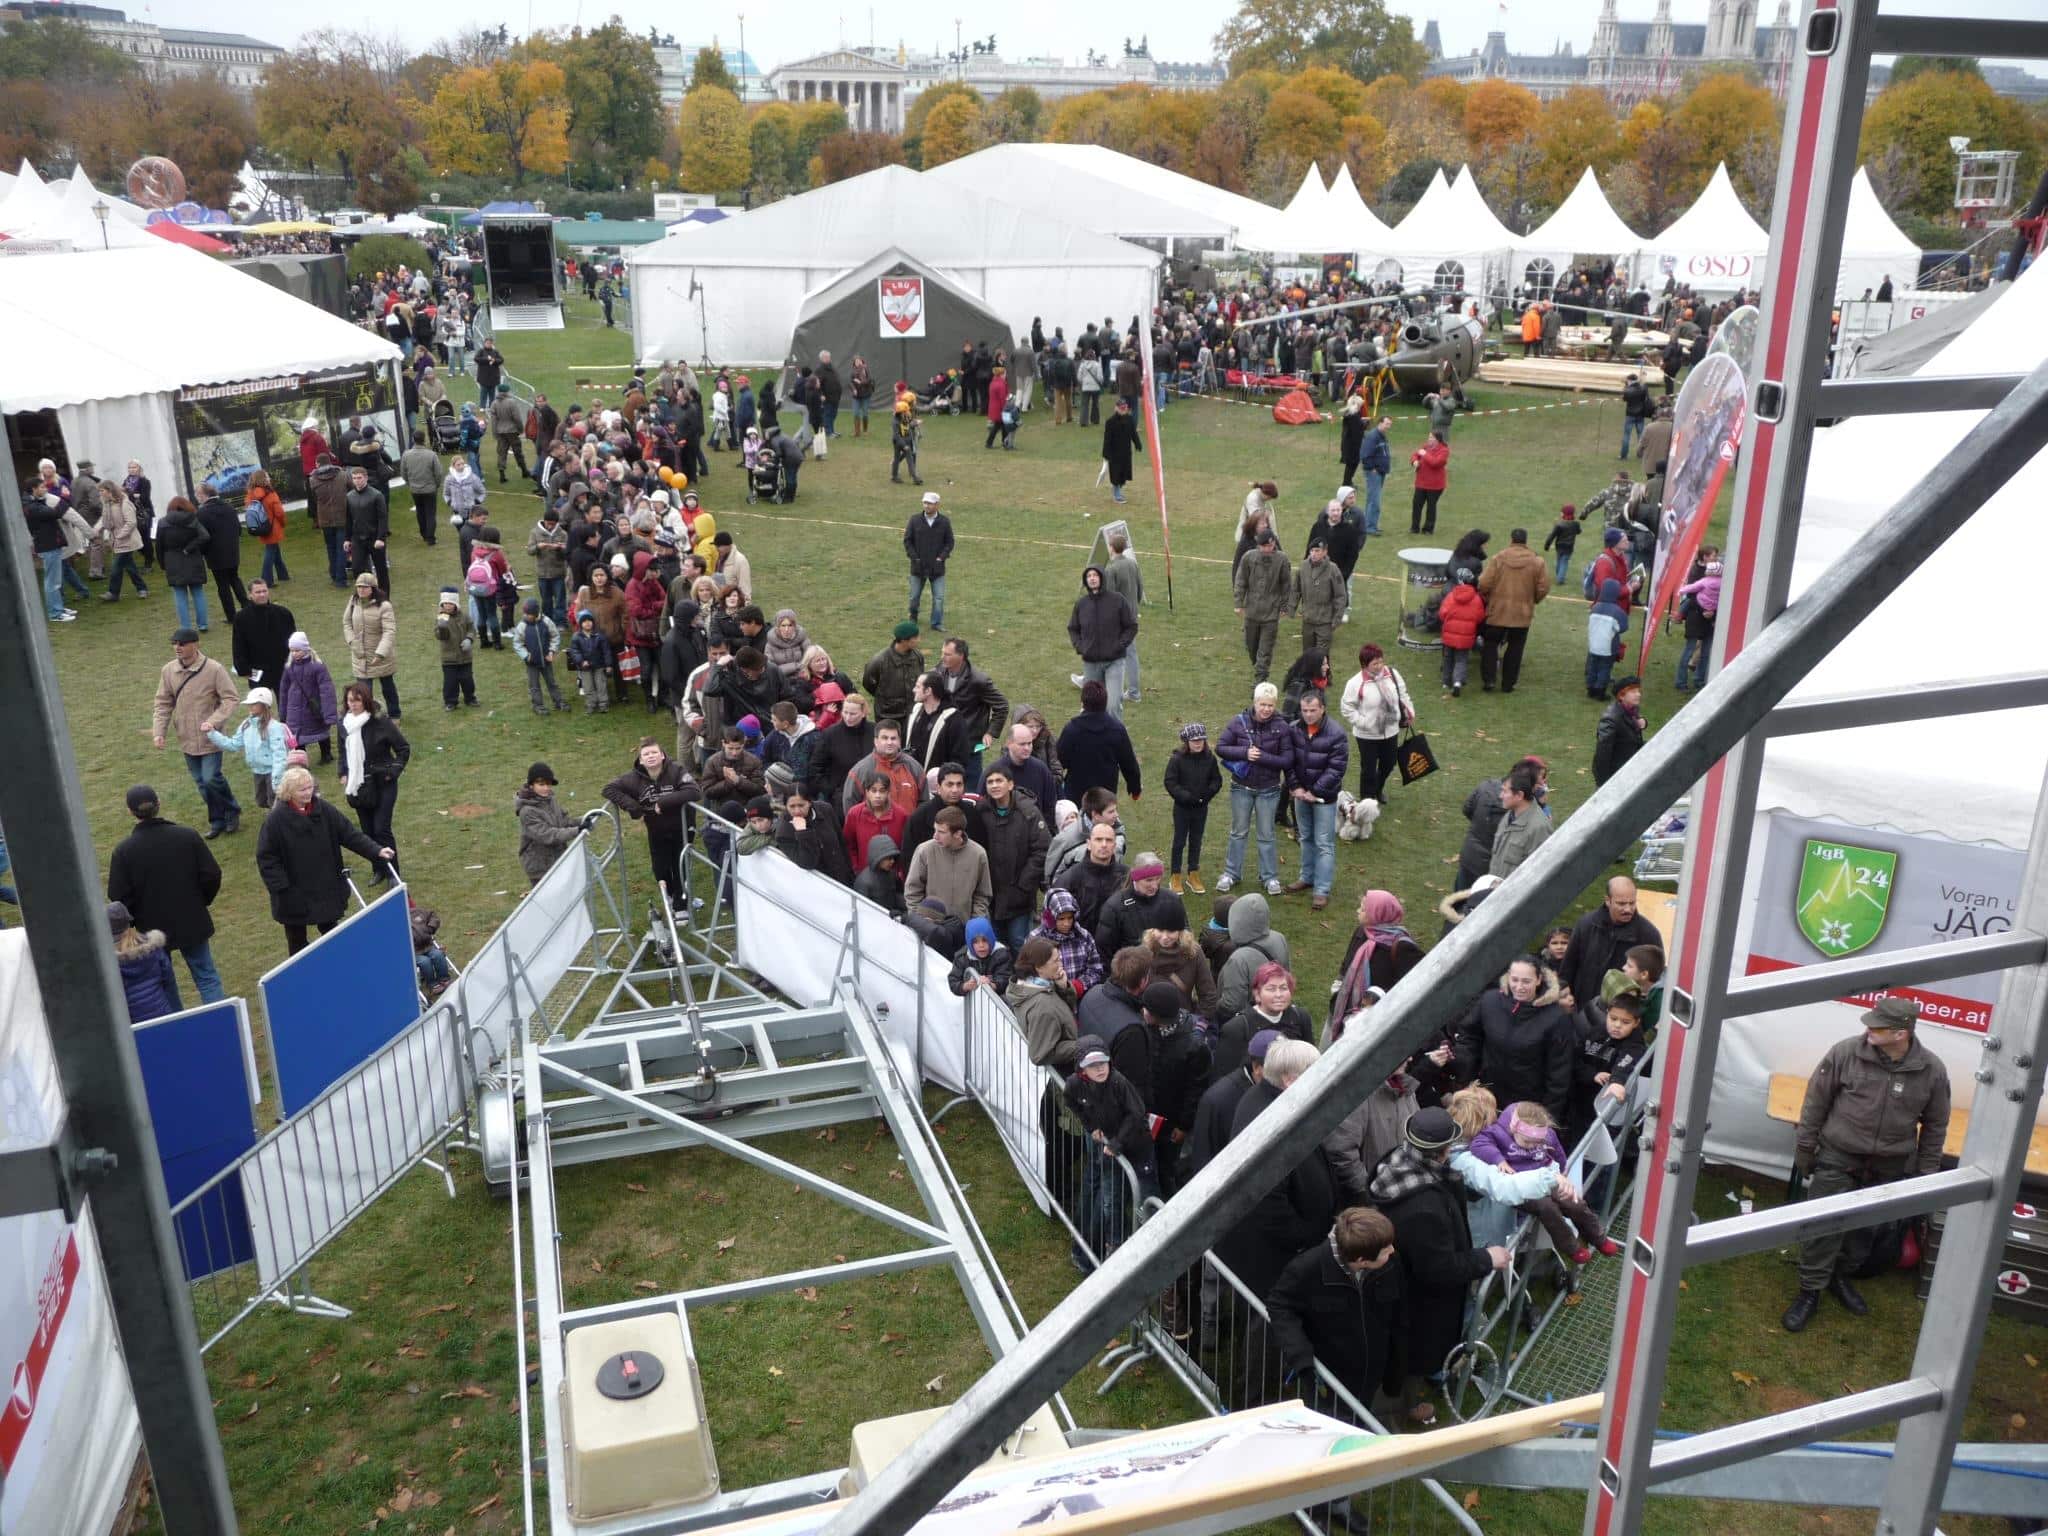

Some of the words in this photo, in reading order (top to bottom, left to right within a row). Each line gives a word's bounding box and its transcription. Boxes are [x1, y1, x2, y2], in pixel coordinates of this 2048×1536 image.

[1812, 845, 1845, 861] JgB
[1855, 867, 1889, 888] 24
[1941, 885, 2000, 909] Voran
[1933, 905, 2012, 938] JÄG
